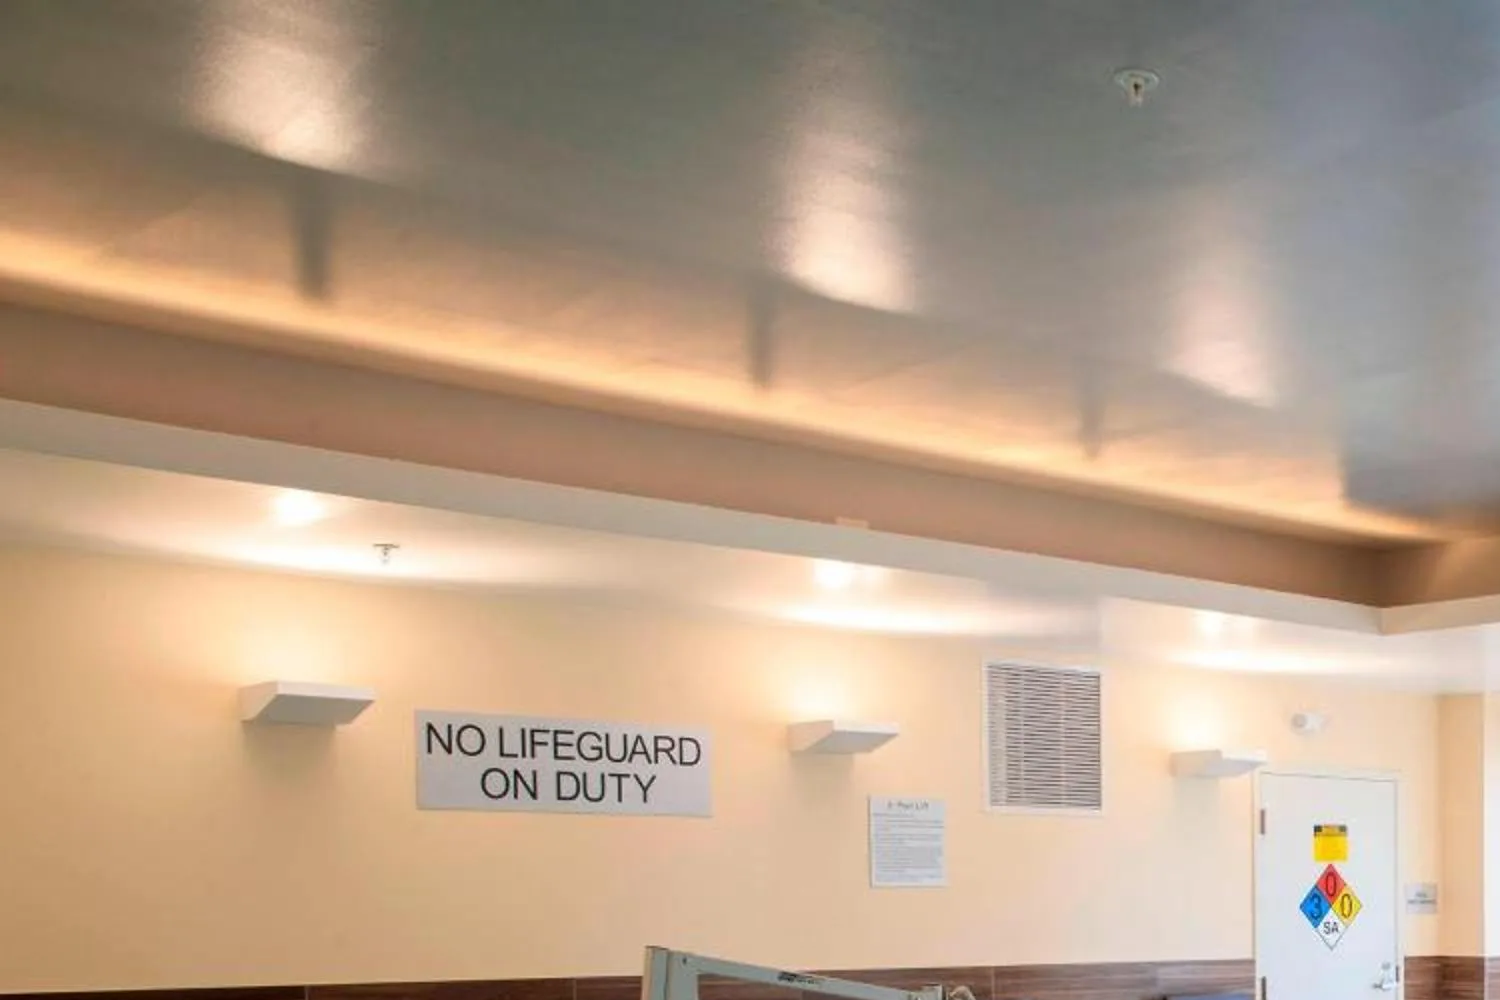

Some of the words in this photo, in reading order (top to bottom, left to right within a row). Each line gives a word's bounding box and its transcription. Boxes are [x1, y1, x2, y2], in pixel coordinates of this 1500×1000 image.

[426, 722, 486, 757] NO
[498, 726, 701, 767] LIFEGUARD
[480, 767, 538, 800] ON
[556, 771, 656, 803] DUTY
[1325, 871, 1337, 897] 0
[1309, 893, 1322, 921] 3
[1340, 893, 1353, 919] 0
